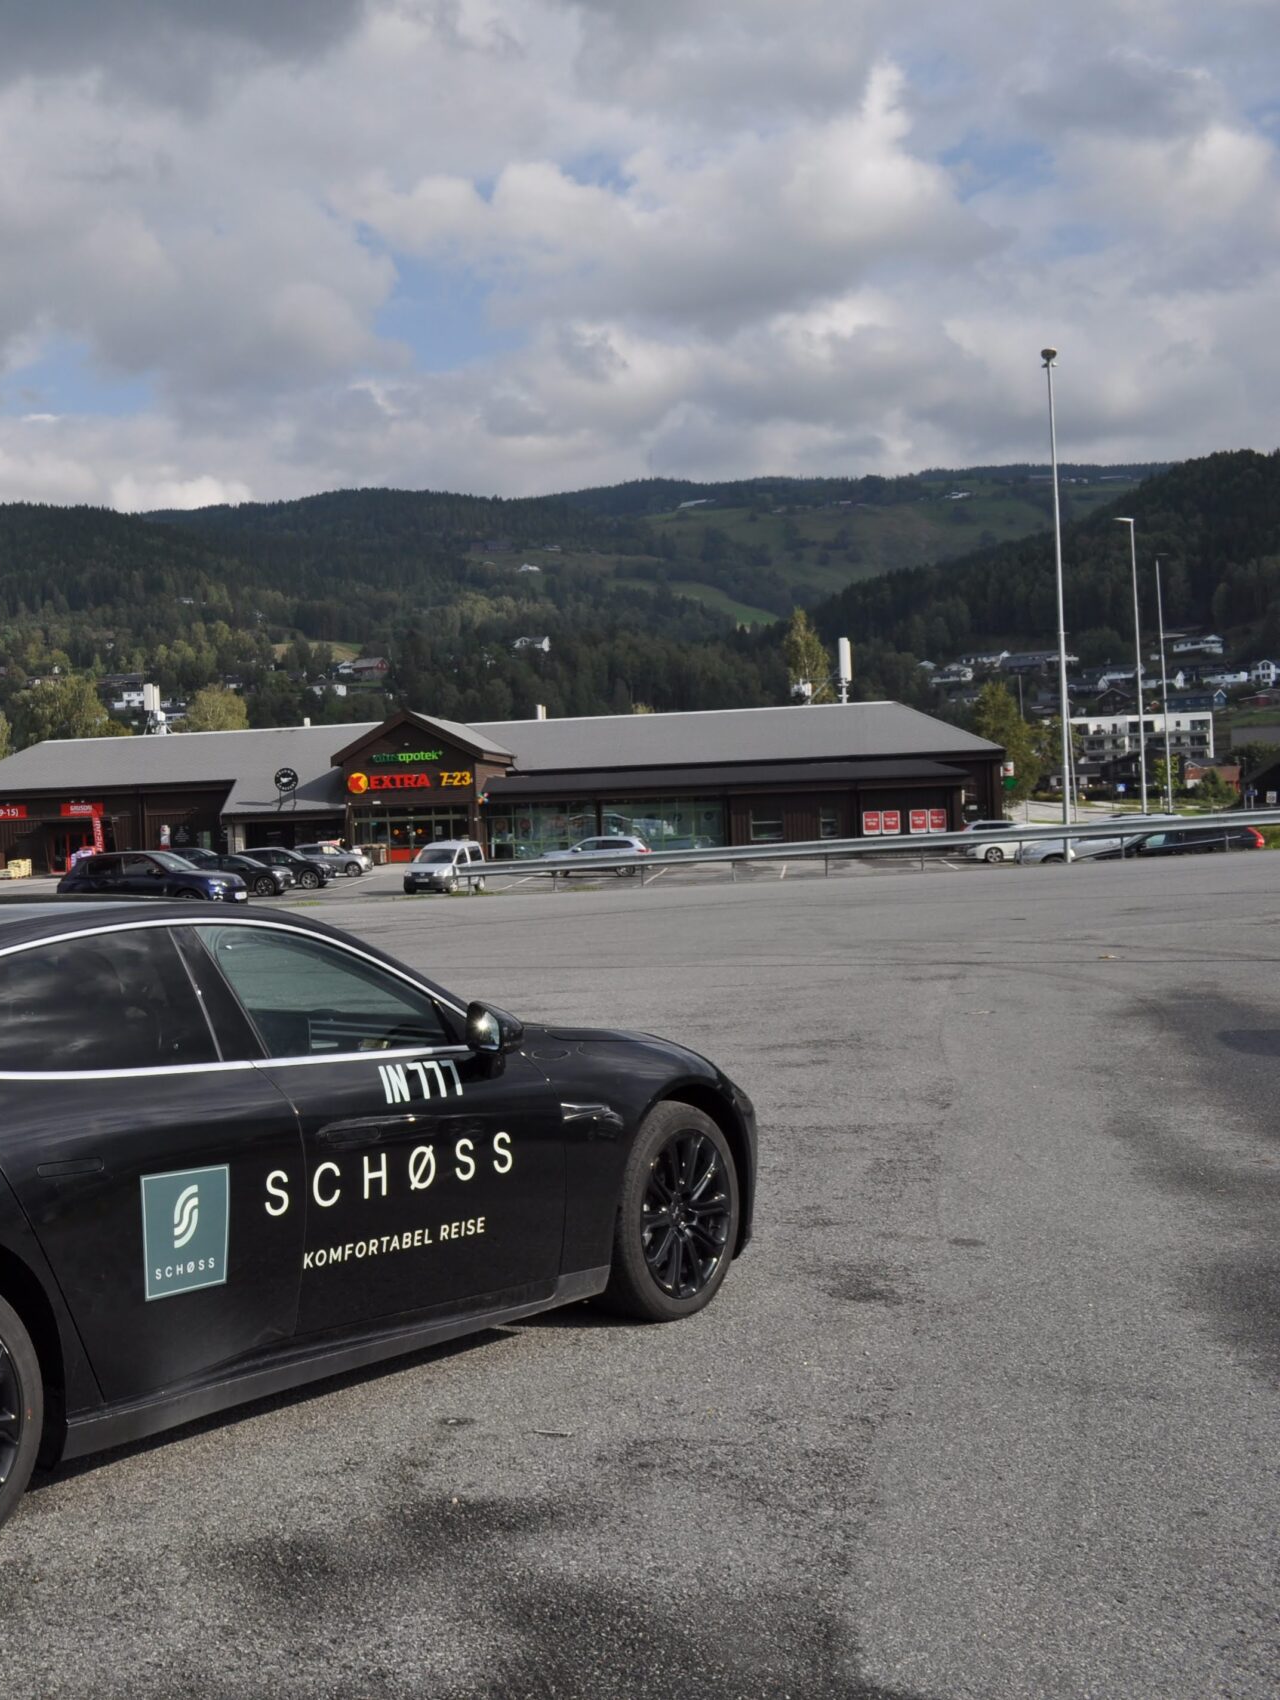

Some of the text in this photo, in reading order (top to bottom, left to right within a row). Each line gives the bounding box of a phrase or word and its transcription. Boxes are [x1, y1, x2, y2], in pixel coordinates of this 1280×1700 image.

[369, 771, 471, 789] EXTRA 7-23
[378, 1060, 463, 1104] IN 777
[264, 1132, 513, 1216] SCHØSS
[304, 1217, 485, 1270] KOMFORTABEL REISE
[155, 1257, 215, 1281] SCHØSS
